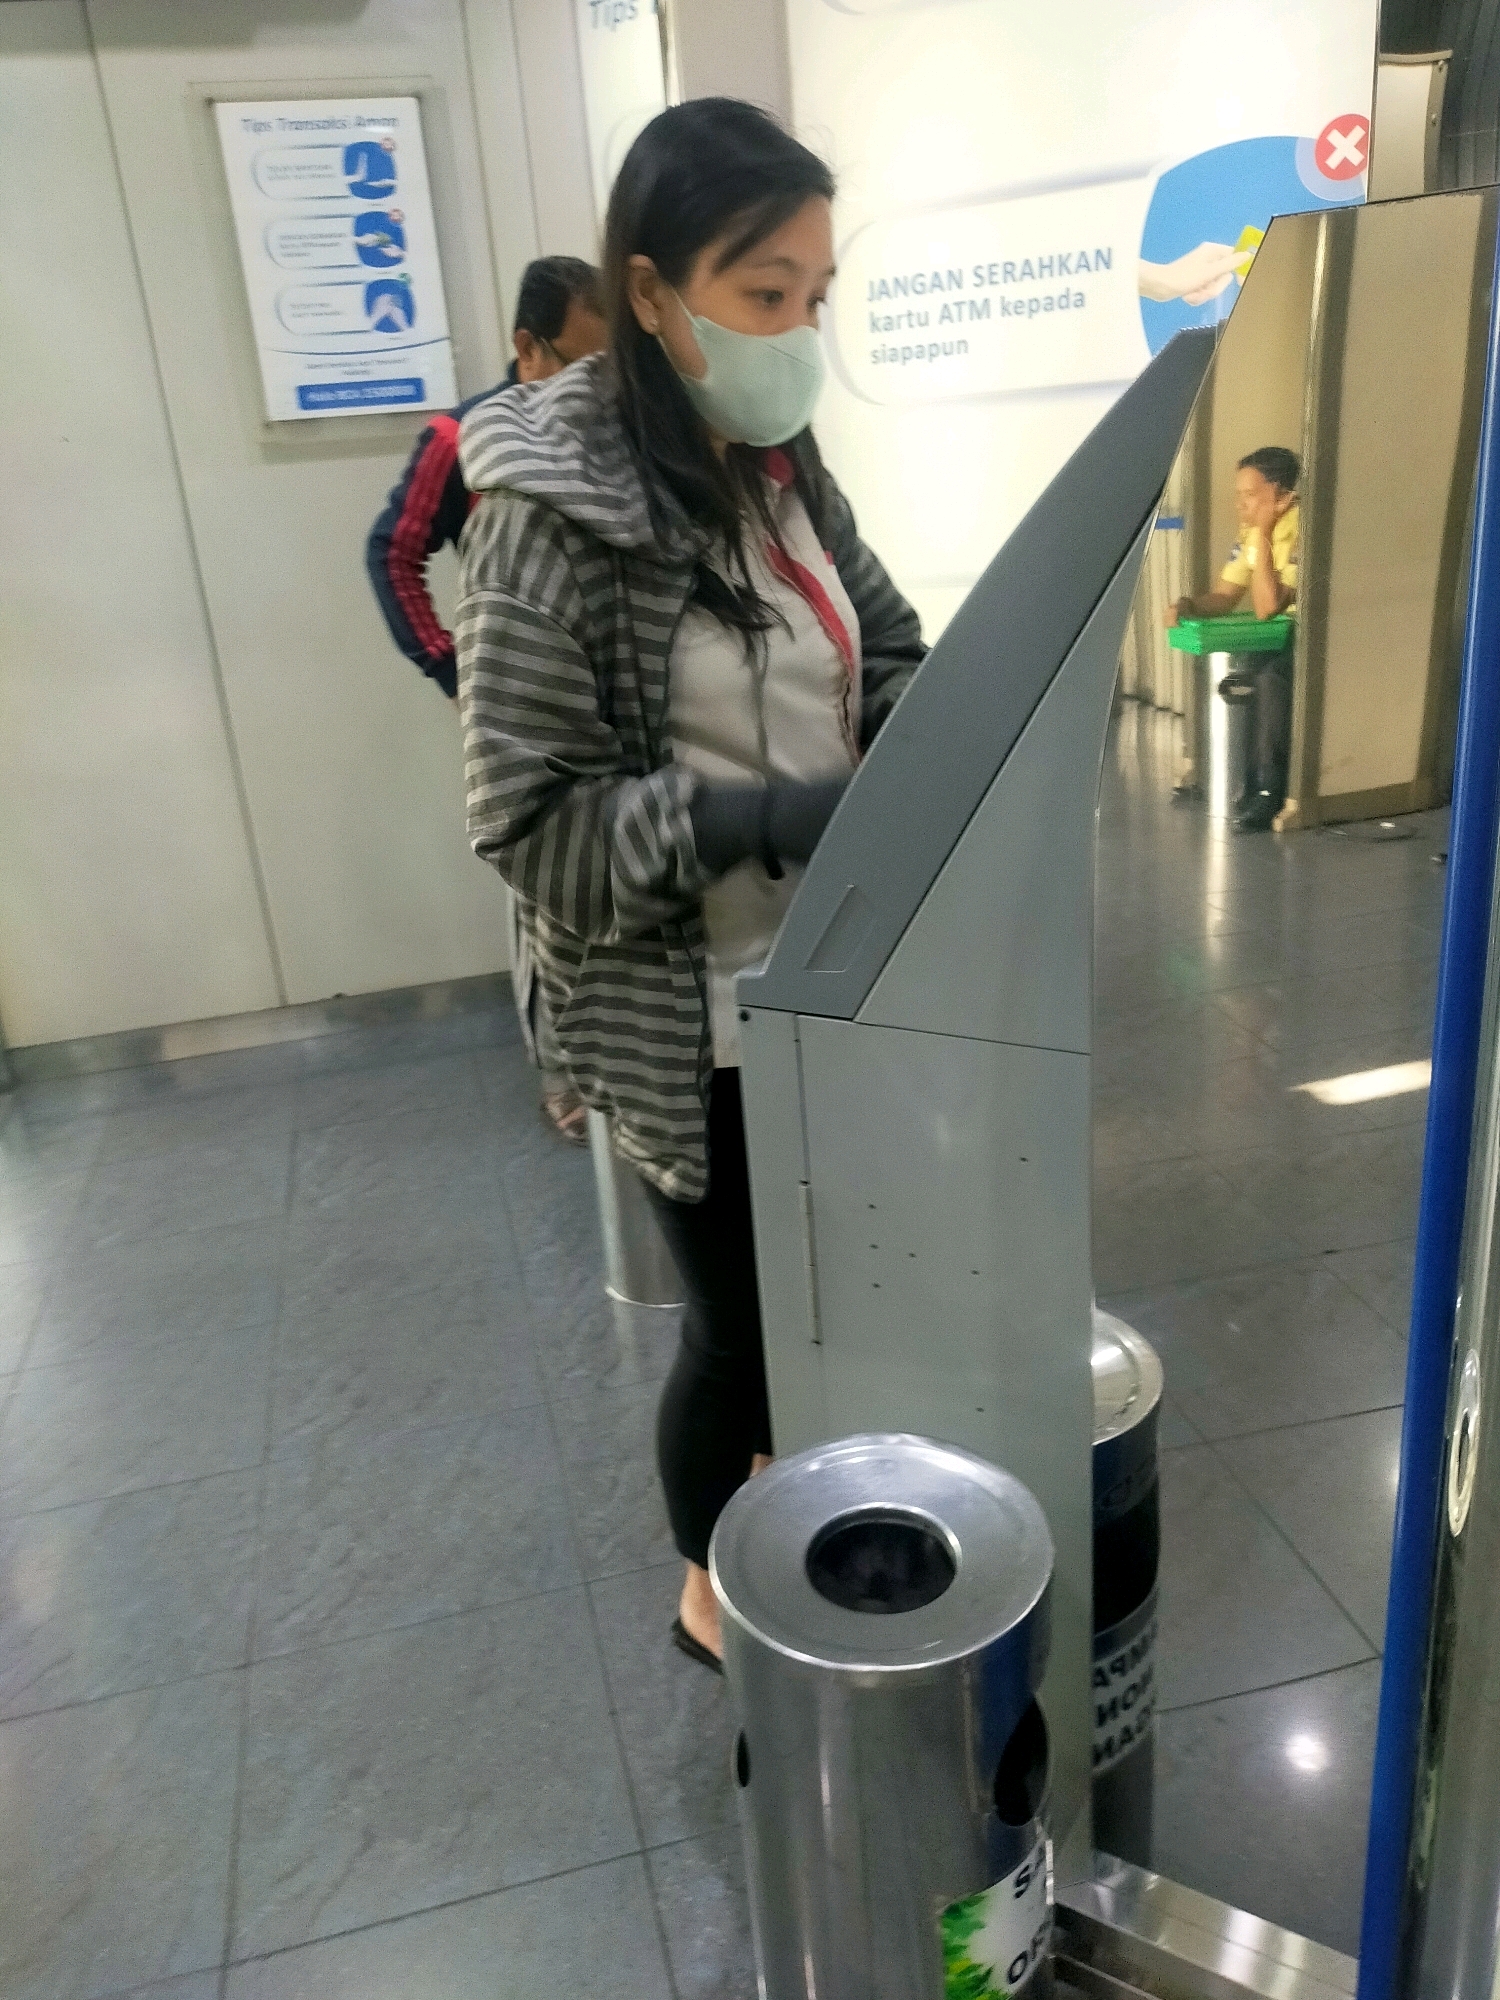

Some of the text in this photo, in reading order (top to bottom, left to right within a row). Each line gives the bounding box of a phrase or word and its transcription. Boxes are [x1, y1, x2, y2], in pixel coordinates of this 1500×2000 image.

[867, 246, 1113, 303] JANGAN SERAHKAN
[868, 287, 1086, 333] kartu ATM kepada
[871, 338, 969, 366] siapapun
